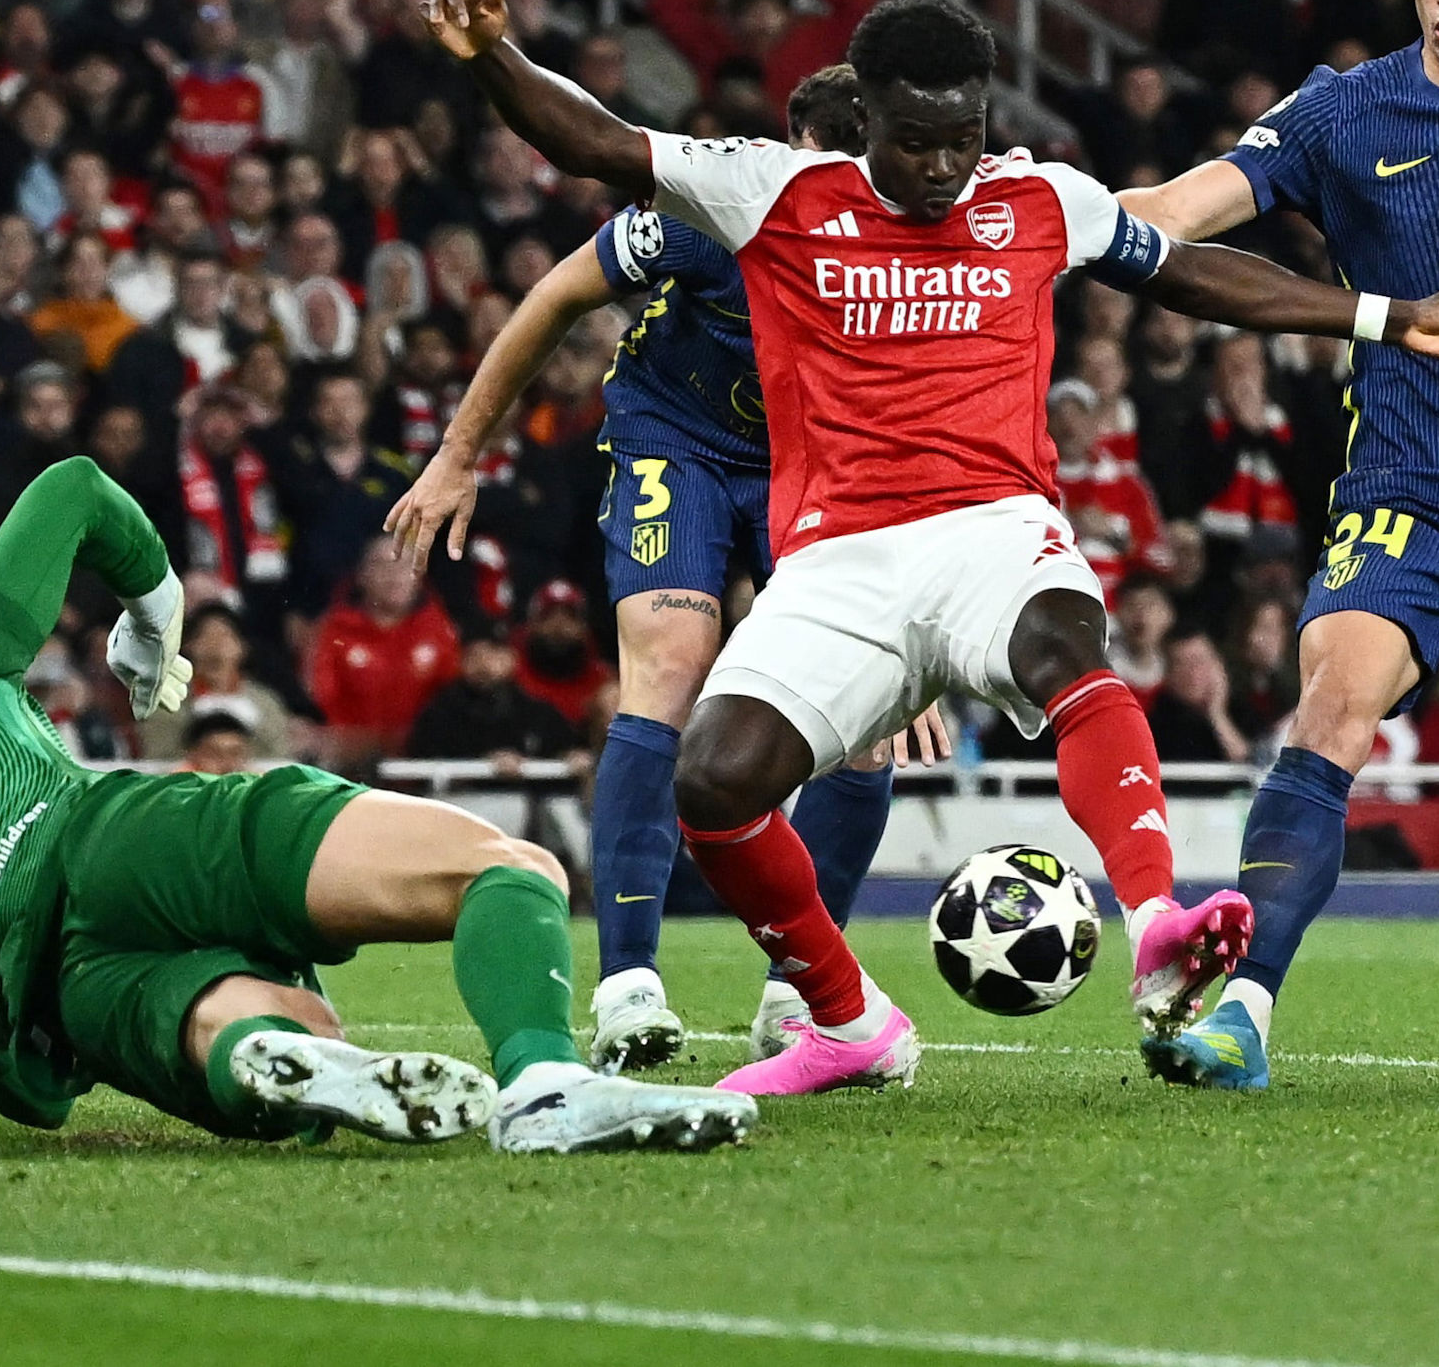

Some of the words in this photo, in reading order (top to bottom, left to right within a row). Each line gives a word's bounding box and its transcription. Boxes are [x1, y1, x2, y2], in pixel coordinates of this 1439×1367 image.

[1118, 242, 1132, 262] NO
[1125, 227, 1134, 242] TO
[814, 257, 1011, 298] Emirates
[843, 301, 879, 335] FLY
[890, 300, 982, 334] BETTER
[632, 458, 671, 520] 3
[1327, 508, 1415, 565] 24
